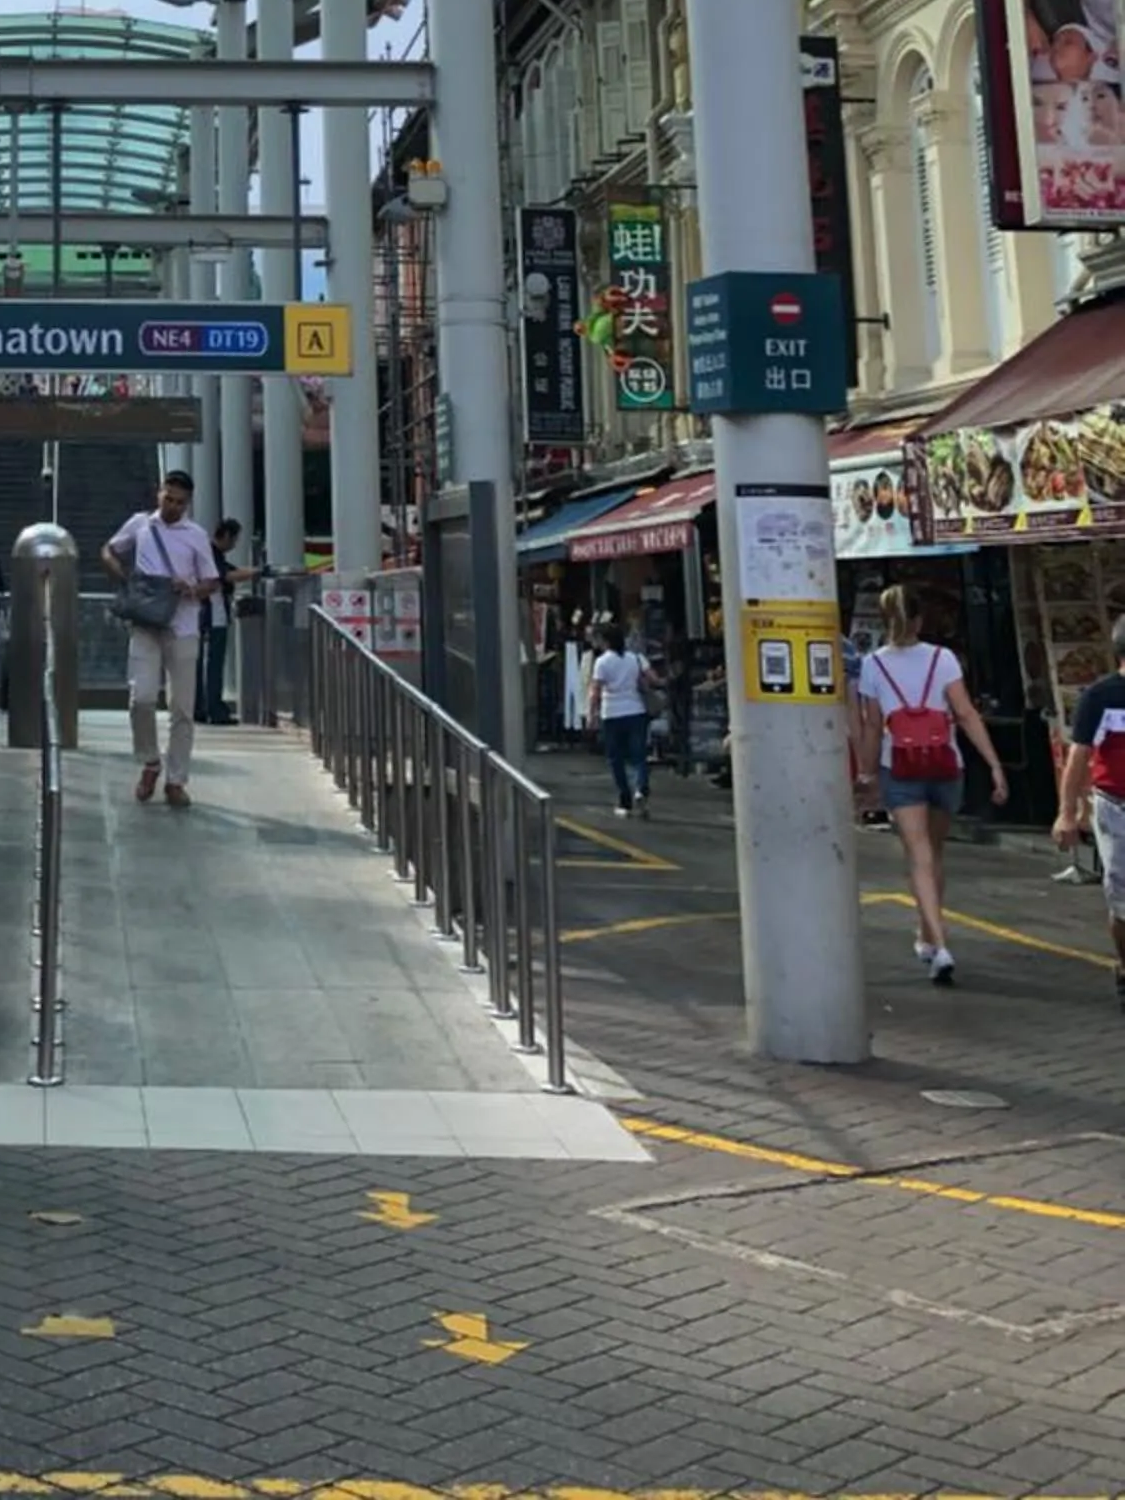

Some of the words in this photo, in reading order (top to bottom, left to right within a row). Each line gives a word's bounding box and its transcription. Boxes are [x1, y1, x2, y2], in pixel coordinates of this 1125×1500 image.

[151, 329, 192, 348] NE4
[208, 329, 260, 348] DT19
[307, 329, 325, 351] A
[764, 338, 808, 357] EXIT
[764, 366, 812, 390] 出口
